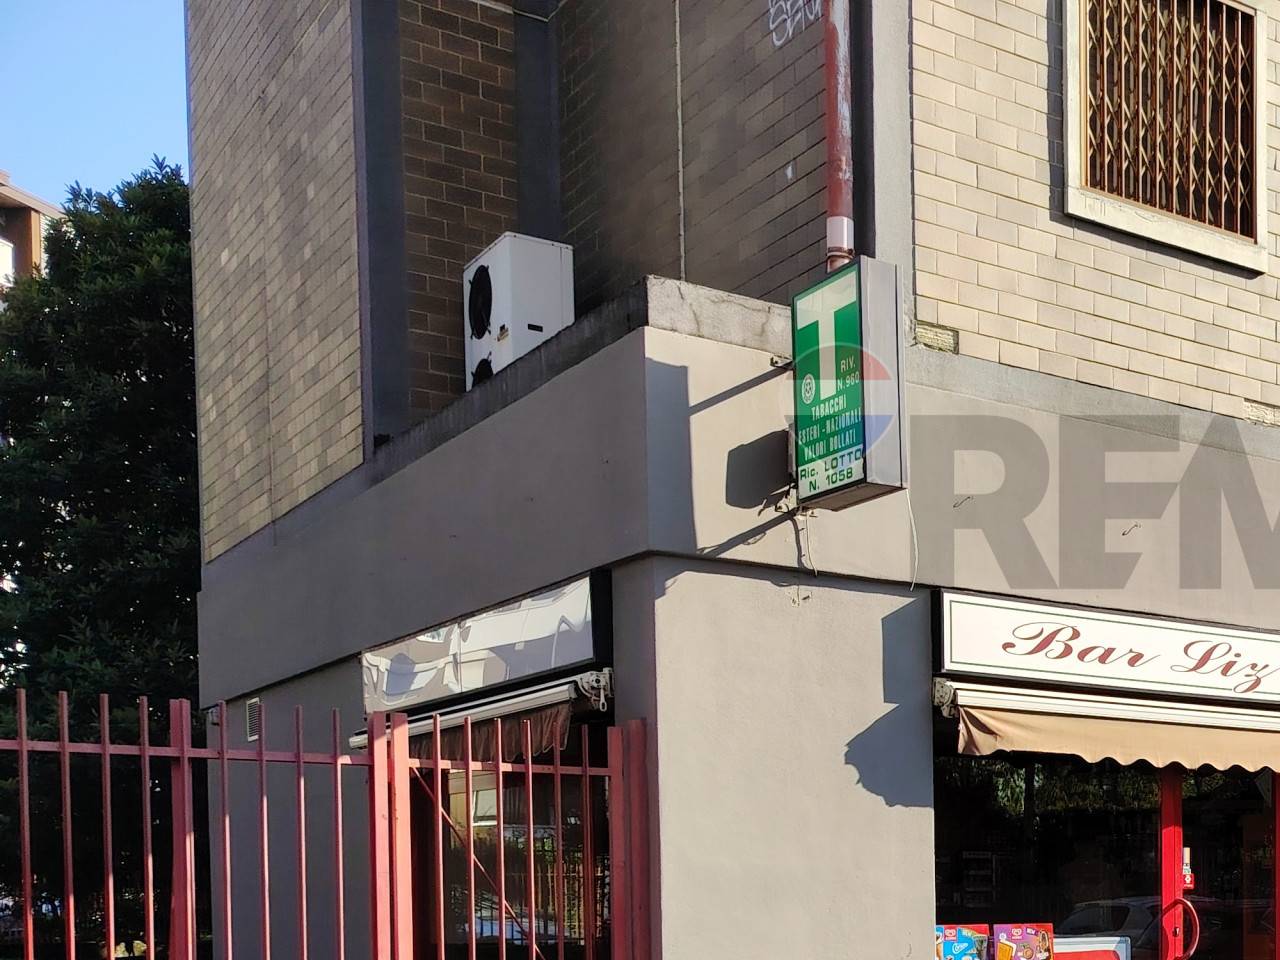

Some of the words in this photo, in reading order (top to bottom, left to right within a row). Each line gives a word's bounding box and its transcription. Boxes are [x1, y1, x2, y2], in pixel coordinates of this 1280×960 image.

[840, 355, 856, 373] RIV.
[811, 394, 847, 421] TABACCHI
[804, 439, 827, 461] VALORI
[829, 428, 856, 452] BOLLATI
[800, 466, 819, 480] Ric.
[824, 449, 863, 472] LOTTO
[809, 479, 820, 492] N.
[825, 467, 853, 486] 1058
[1001, 621, 1161, 669] Bar
